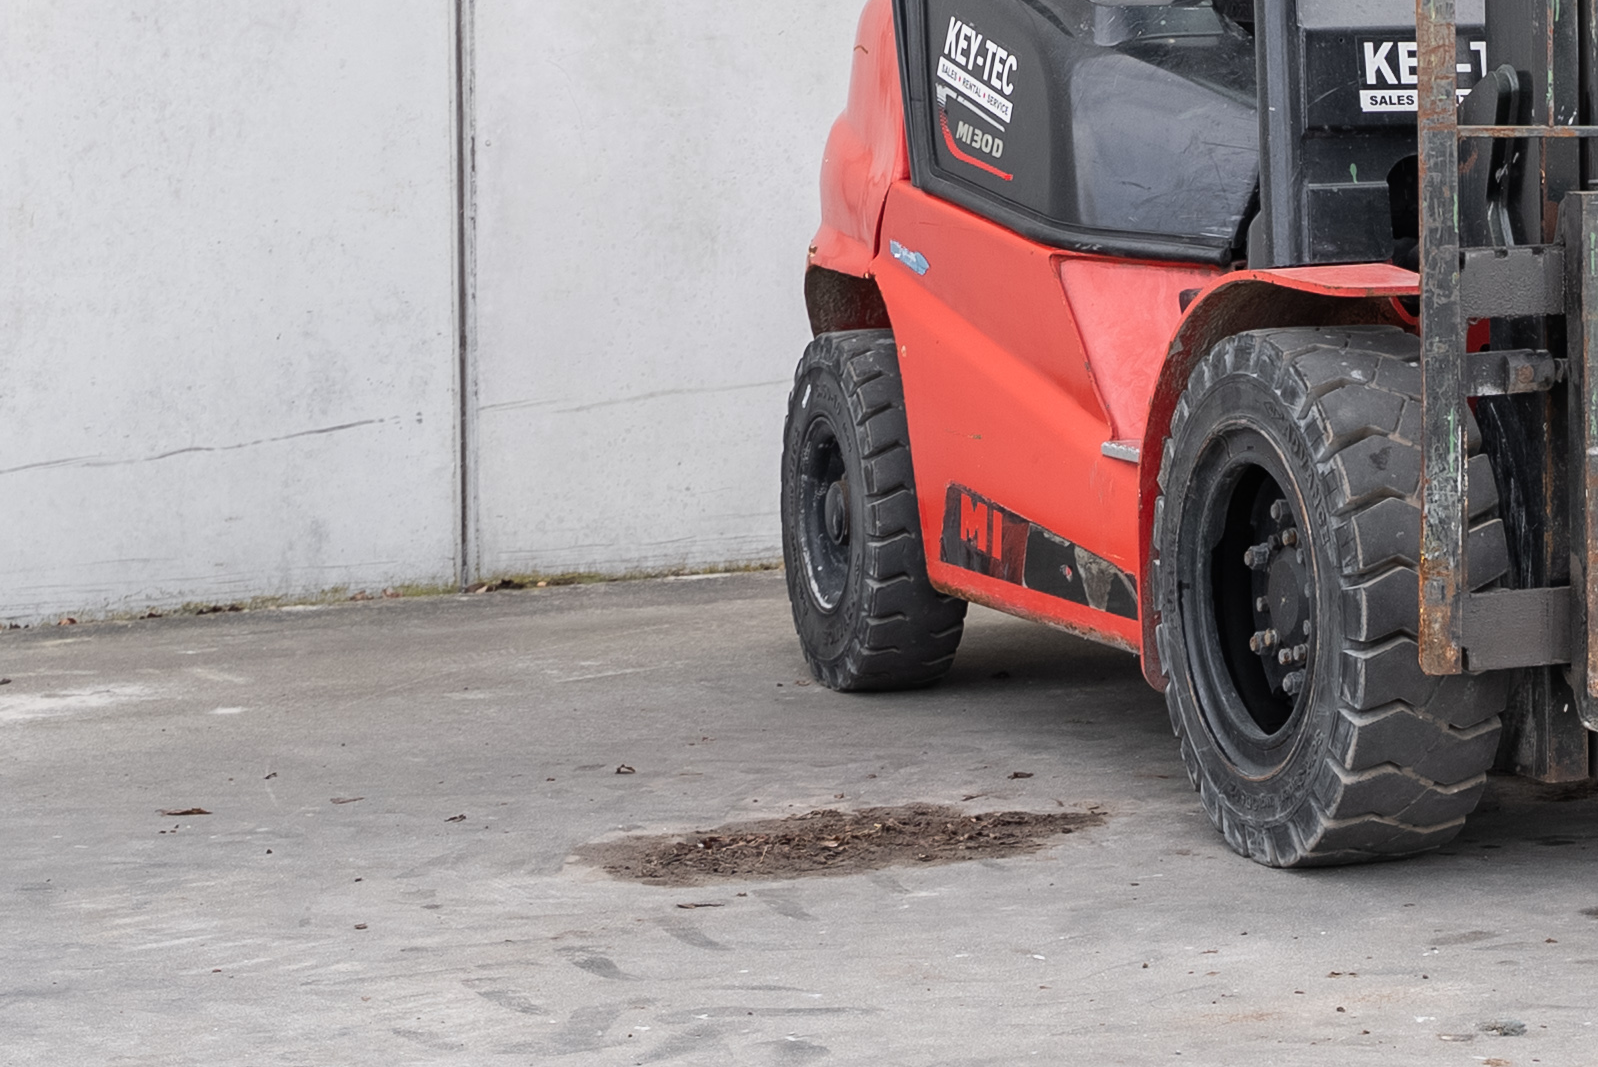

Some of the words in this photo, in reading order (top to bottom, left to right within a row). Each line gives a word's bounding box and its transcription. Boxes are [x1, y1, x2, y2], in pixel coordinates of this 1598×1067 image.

[944, 16, 1018, 96] KEY-TEC
[941, 63, 958, 81] SALES
[962, 77, 982, 98] RENTAL
[987, 93, 1009, 116] SERVICE
[1369, 95, 1415, 106] SALES
[955, 120, 1004, 159] MI30D
[960, 492, 1004, 562] MI
